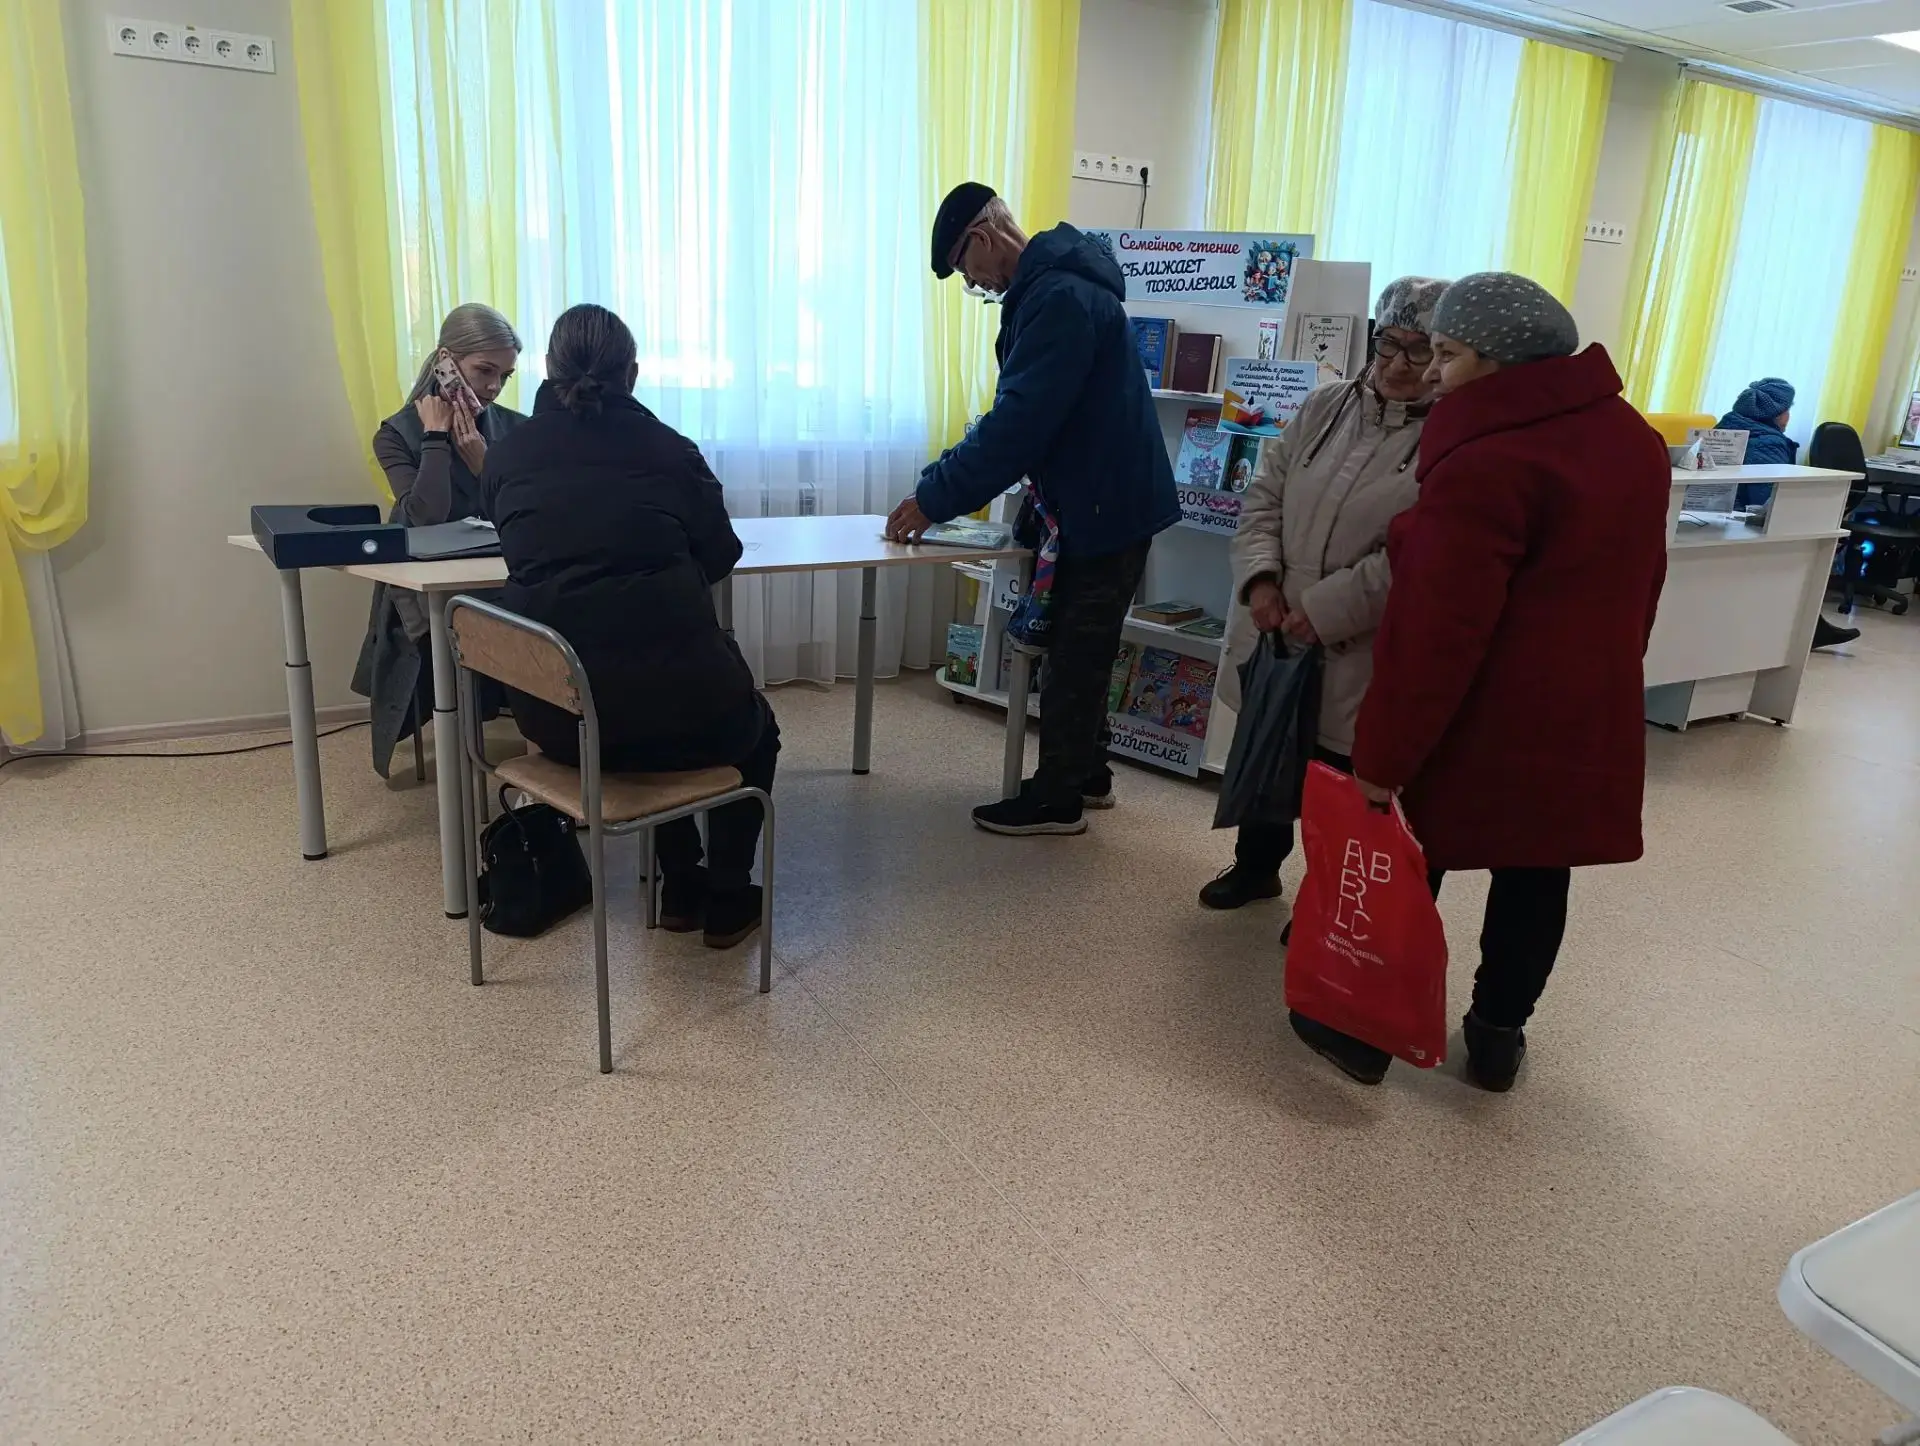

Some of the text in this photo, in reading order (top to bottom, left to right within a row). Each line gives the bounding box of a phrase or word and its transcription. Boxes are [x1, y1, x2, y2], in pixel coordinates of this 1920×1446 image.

[1119, 233, 1241, 255] Семейное чтение
[1120, 259, 1206, 278] СБЛИЖАЕТ
[1146, 274, 1237, 293] ПОКОЛЕНИЯ
[1112, 733, 1188, 765] ОДИТЕЛЕЙ
[1130, 726, 1191, 751] заботливых
